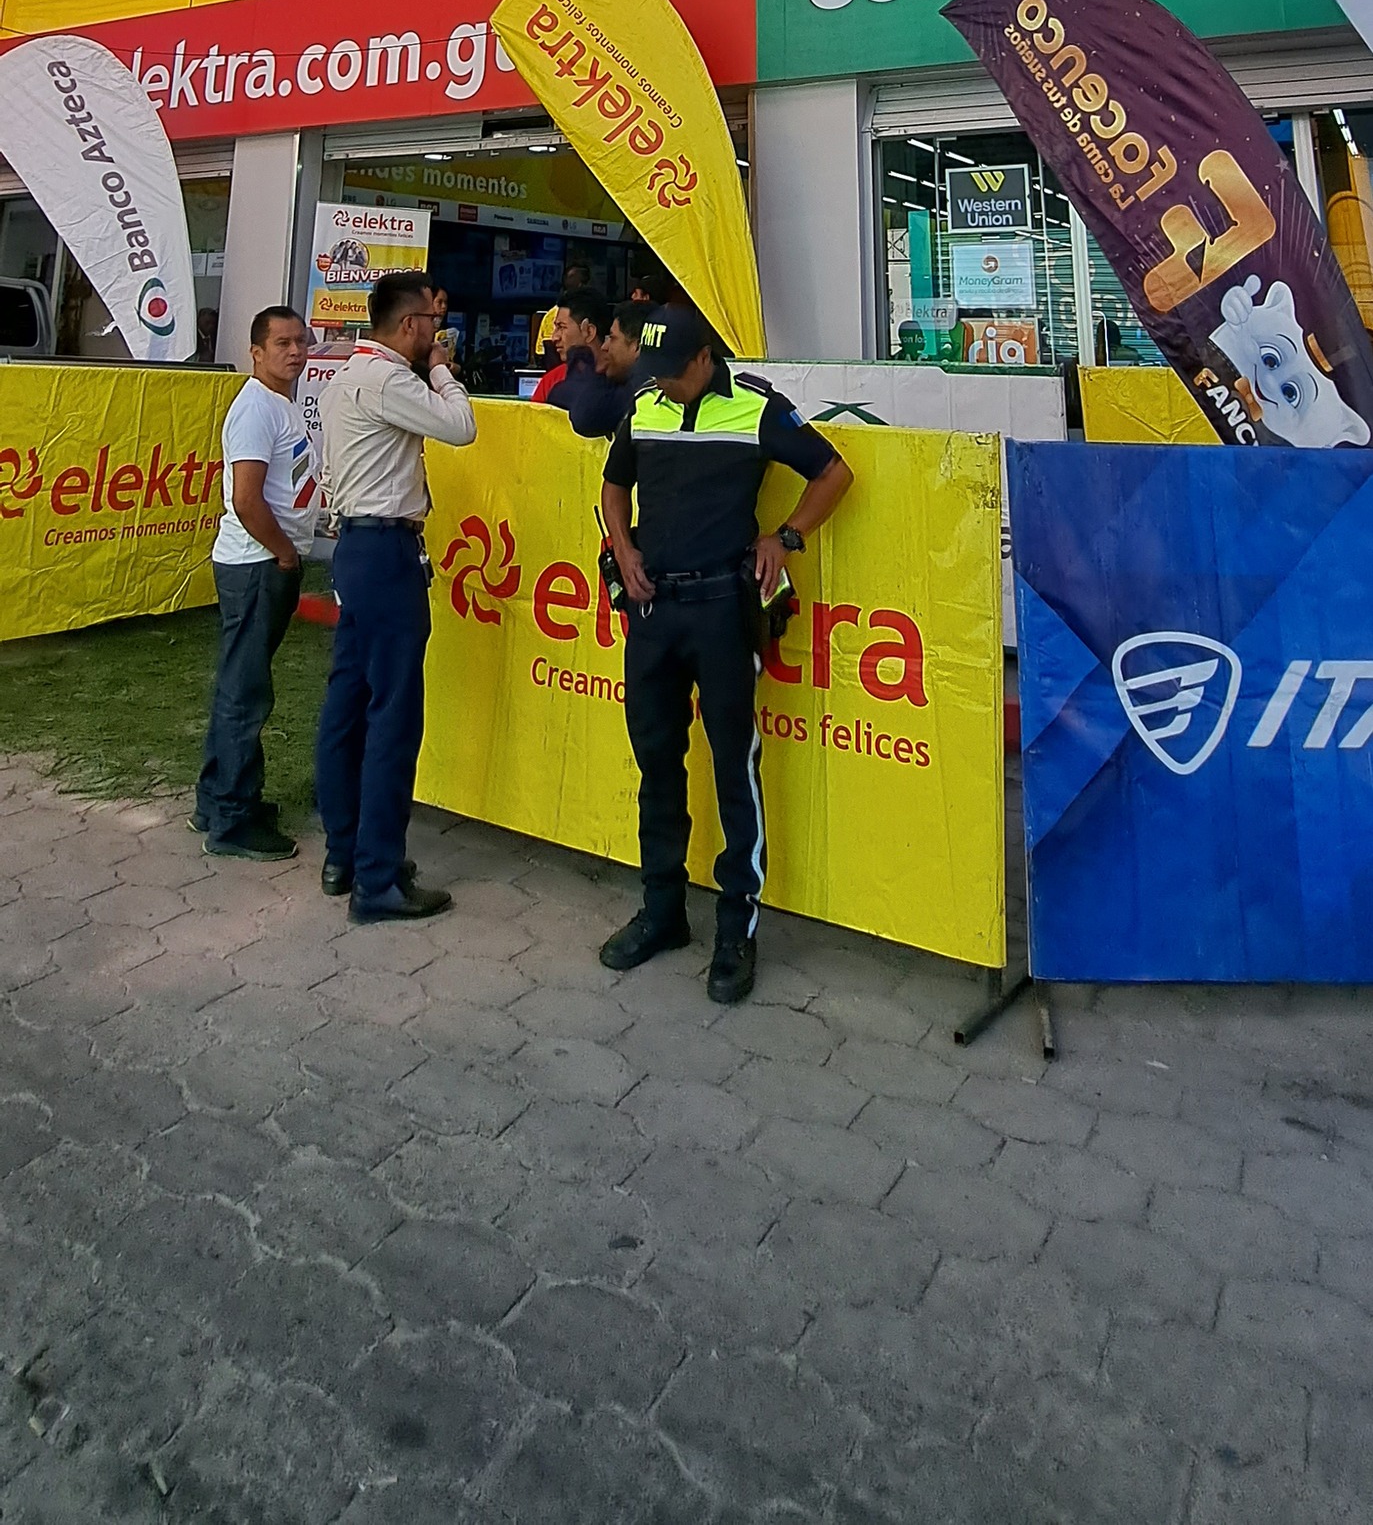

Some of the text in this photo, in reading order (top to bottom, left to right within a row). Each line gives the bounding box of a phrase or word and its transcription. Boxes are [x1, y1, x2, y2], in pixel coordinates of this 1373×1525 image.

[130, 21, 516, 110] lektra.com.g
[585, 23, 640, 79] momentos
[525, 3, 664, 156] elektra
[638, 78, 683, 129] Creamos
[47, 60, 159, 273] Banco Azteca
[423, 167, 528, 199] momentos
[352, 212, 414, 232] elektra
[957, 198, 1022, 213] Western
[966, 212, 1013, 227] Union
[326, 268, 422, 282] BIENVEN
[958, 274, 1023, 287] MoneyGram
[333, 301, 367, 313] elektra
[640, 322, 667, 348] PMT
[1193, 367, 1260, 447] FANC
[51, 443, 225, 516] elektr
[44, 512, 223, 547] Creamos momentos feli
[531, 657, 626, 705] Creamo
[819, 713, 932, 768] felices
